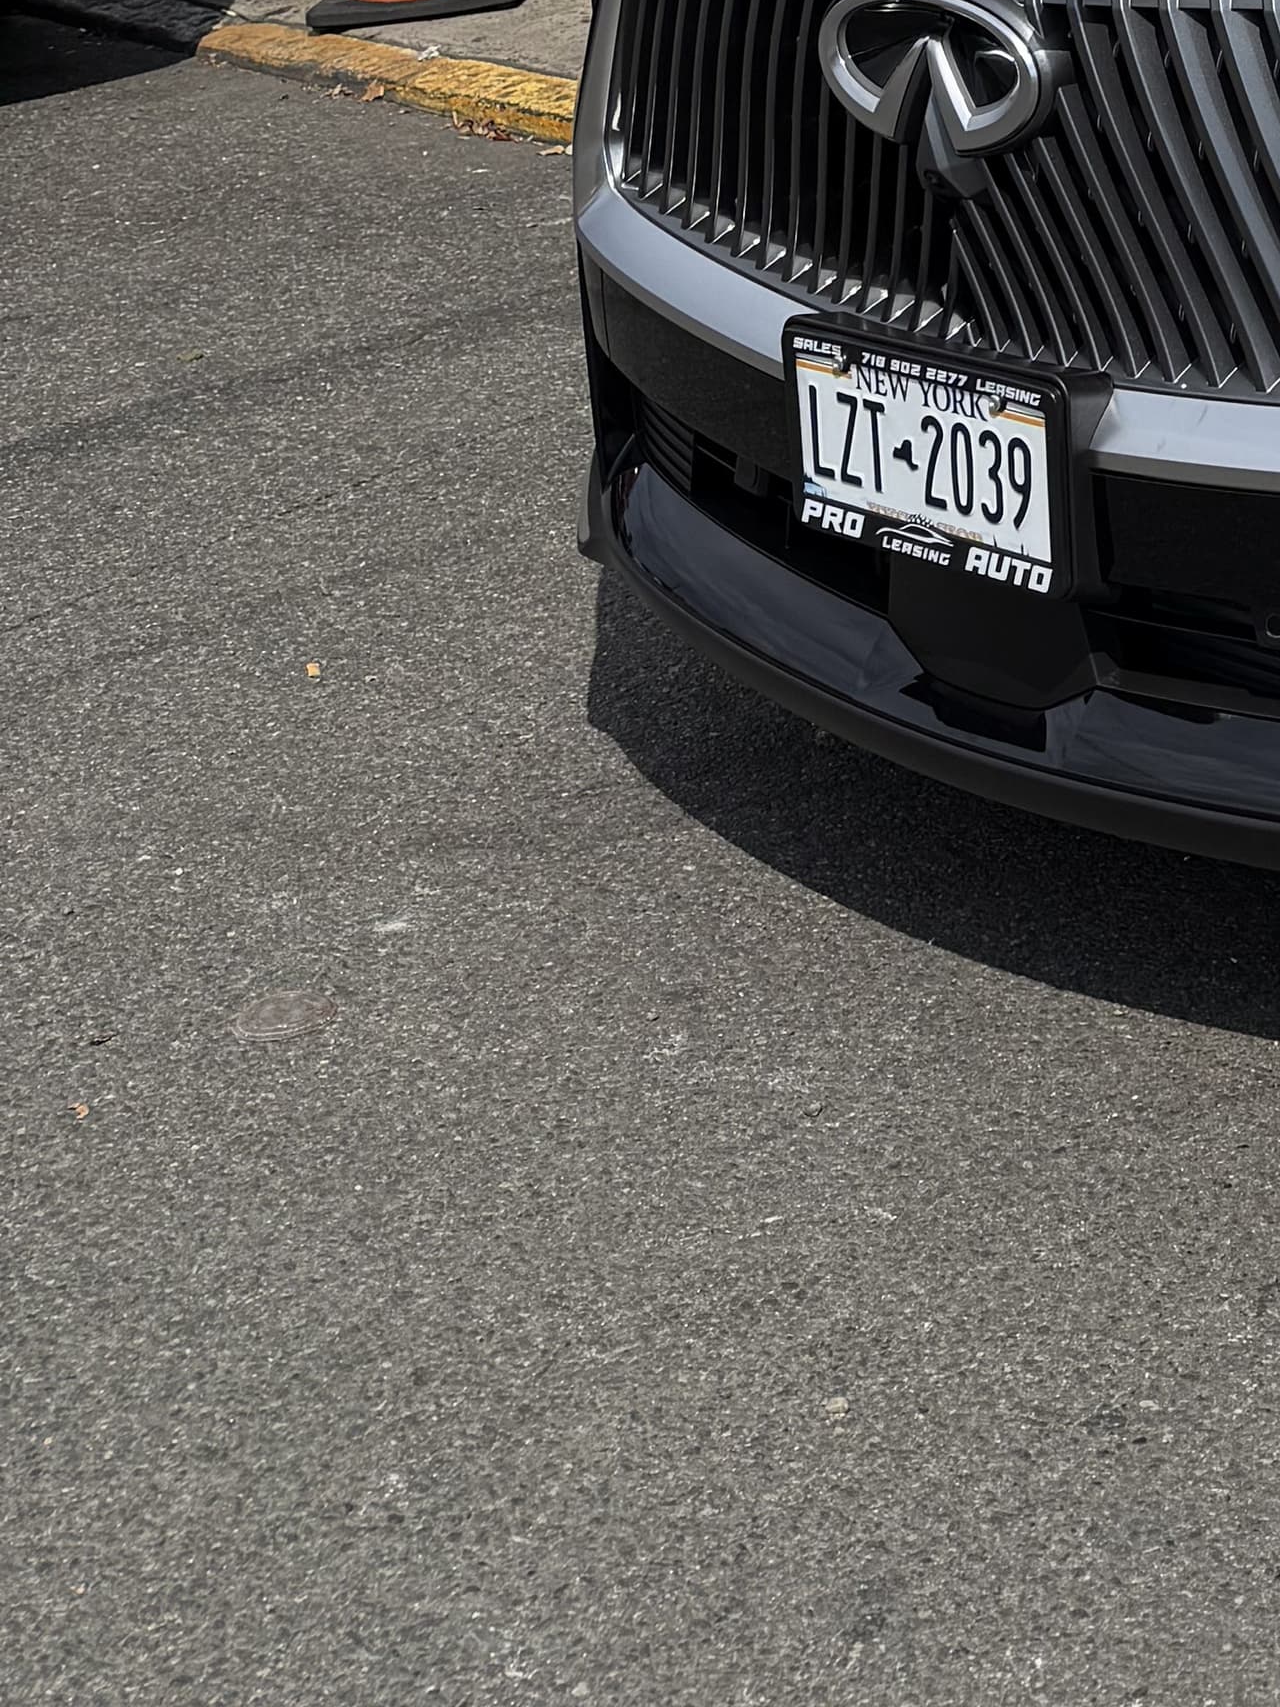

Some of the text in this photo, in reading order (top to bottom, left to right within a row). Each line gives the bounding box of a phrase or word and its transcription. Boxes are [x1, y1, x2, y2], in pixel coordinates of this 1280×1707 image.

[793, 337, 1042, 407] SALES 718 902 2277 LEASING
[854, 365, 988, 422] NEW YORK
[808, 385, 1032, 531] LZT 2039
[801, 498, 865, 539] PRO
[882, 535, 951, 566] LEASING
[964, 546, 1053, 594] AUTO
